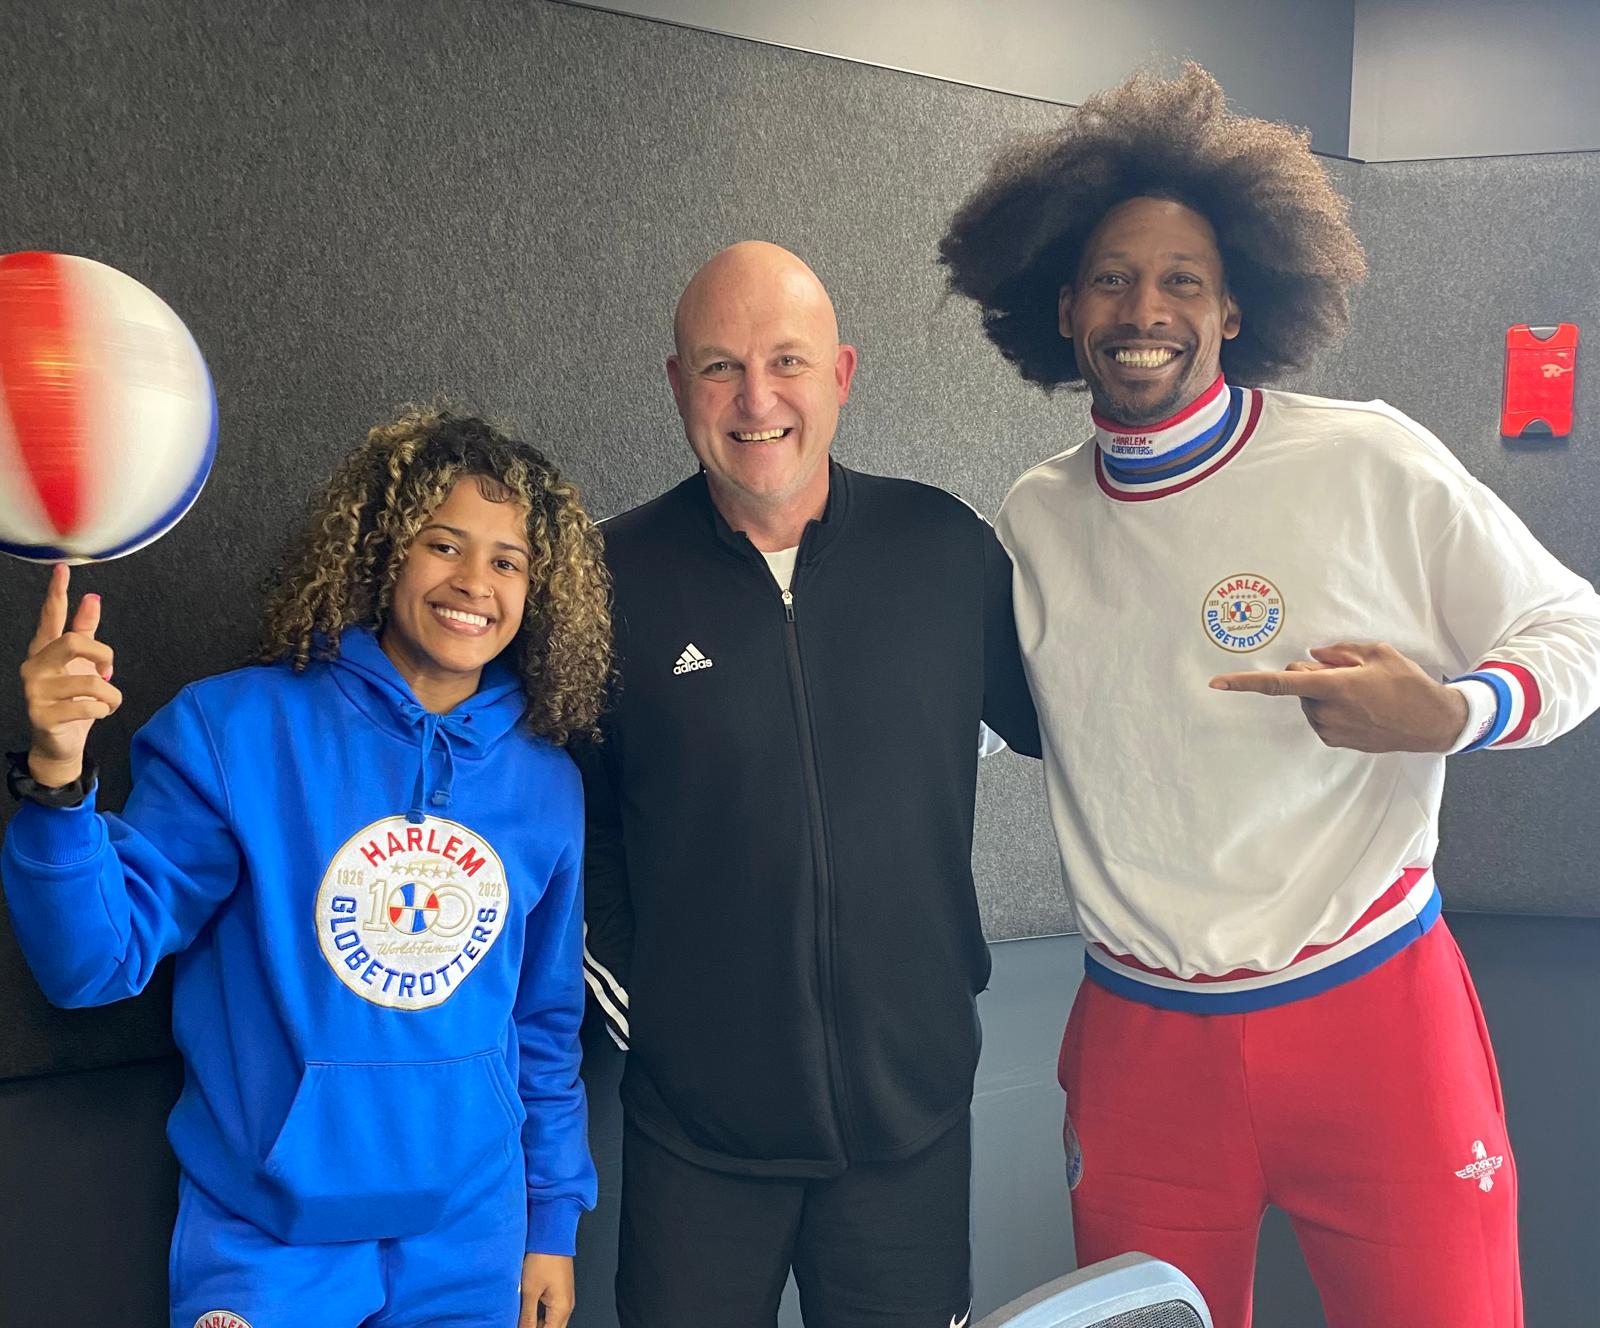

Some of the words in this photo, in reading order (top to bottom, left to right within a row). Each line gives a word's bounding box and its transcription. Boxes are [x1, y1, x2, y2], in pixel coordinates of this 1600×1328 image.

[1116, 436, 1146, 446] HARLEM
[1217, 579, 1271, 598] HARLEM
[1207, 607, 1280, 648] GLOBETROTTERS
[673, 659, 713, 675] adidas
[360, 827, 487, 877] HARLEM
[337, 868, 364, 886] 1926
[478, 881, 502, 897] 2026
[330, 895, 498, 998] GLOBETROTTERS
